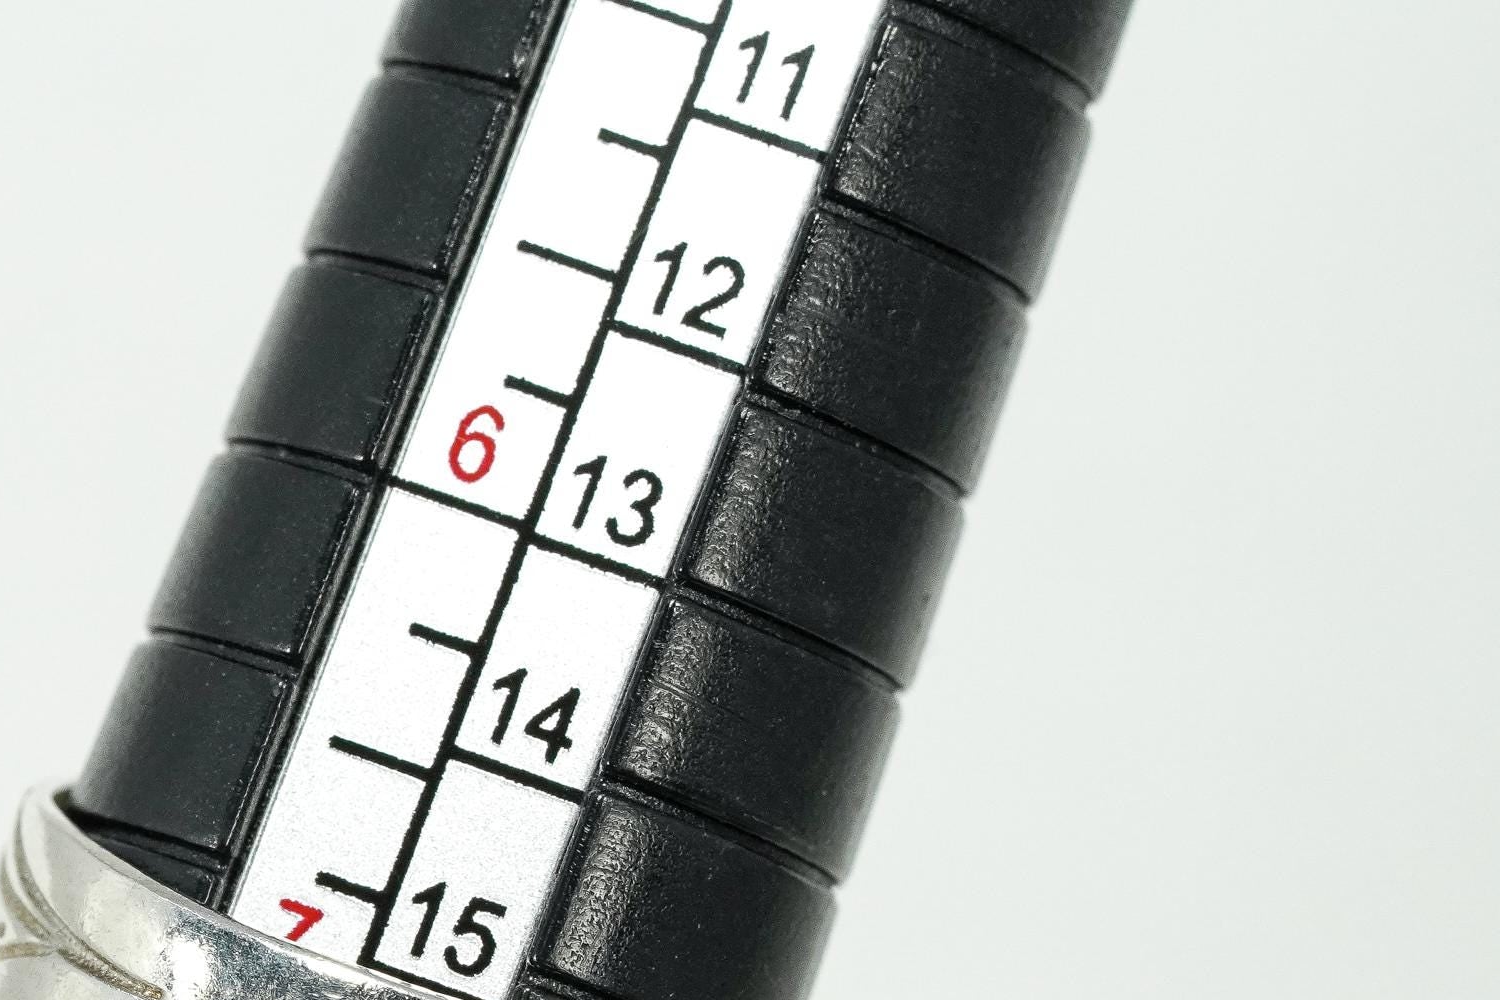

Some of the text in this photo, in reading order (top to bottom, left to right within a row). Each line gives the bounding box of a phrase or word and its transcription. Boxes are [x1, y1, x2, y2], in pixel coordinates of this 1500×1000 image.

[737, 31, 815, 121] 11
[653, 241, 746, 339] 12
[448, 405, 505, 483] 6
[572, 455, 663, 548] 13
[490, 668, 581, 765] 14
[410, 881, 508, 978] 15
